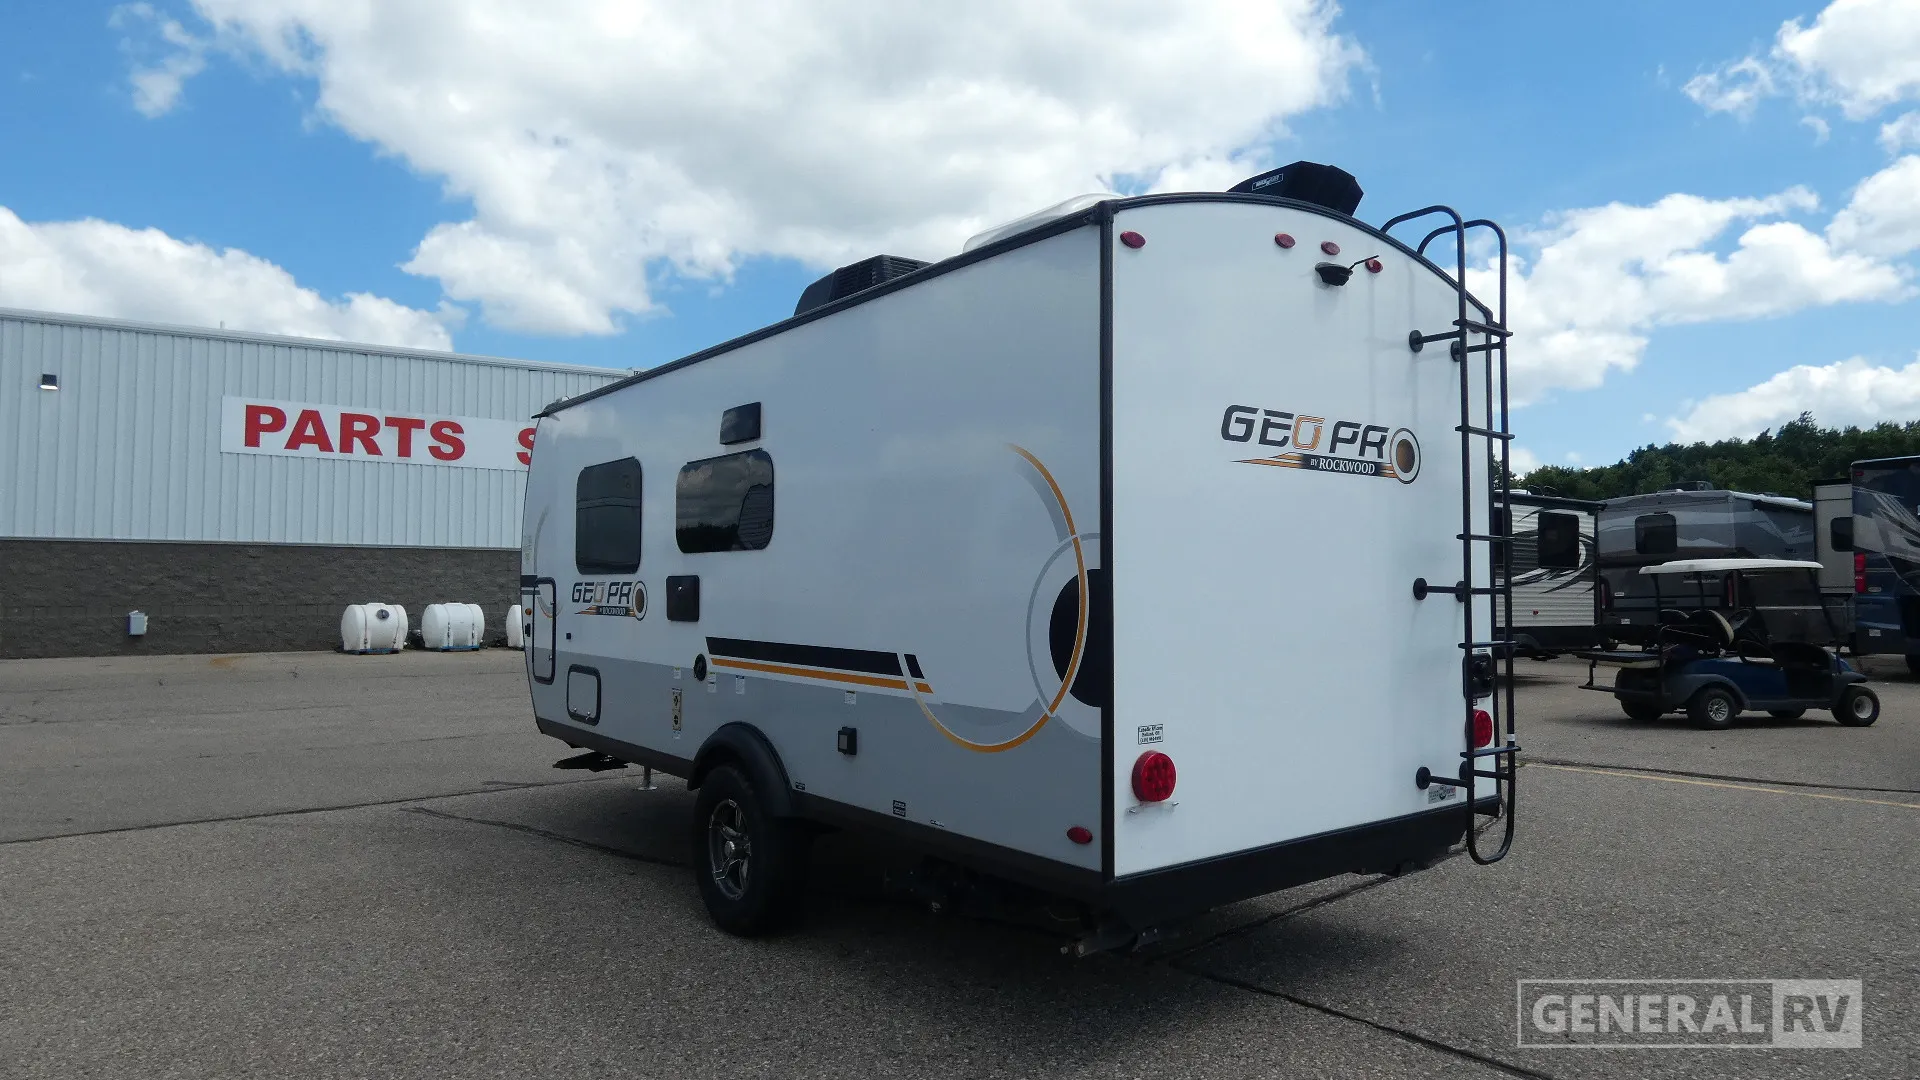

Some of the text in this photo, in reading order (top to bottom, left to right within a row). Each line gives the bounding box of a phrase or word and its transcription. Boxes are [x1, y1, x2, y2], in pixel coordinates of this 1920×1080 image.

[244, 404, 466, 462] PARTS
[1221, 404, 1325, 451] GEO
[1310, 457, 1376, 475] BY ROCKWOOD
[572, 581, 606, 603] GEO
